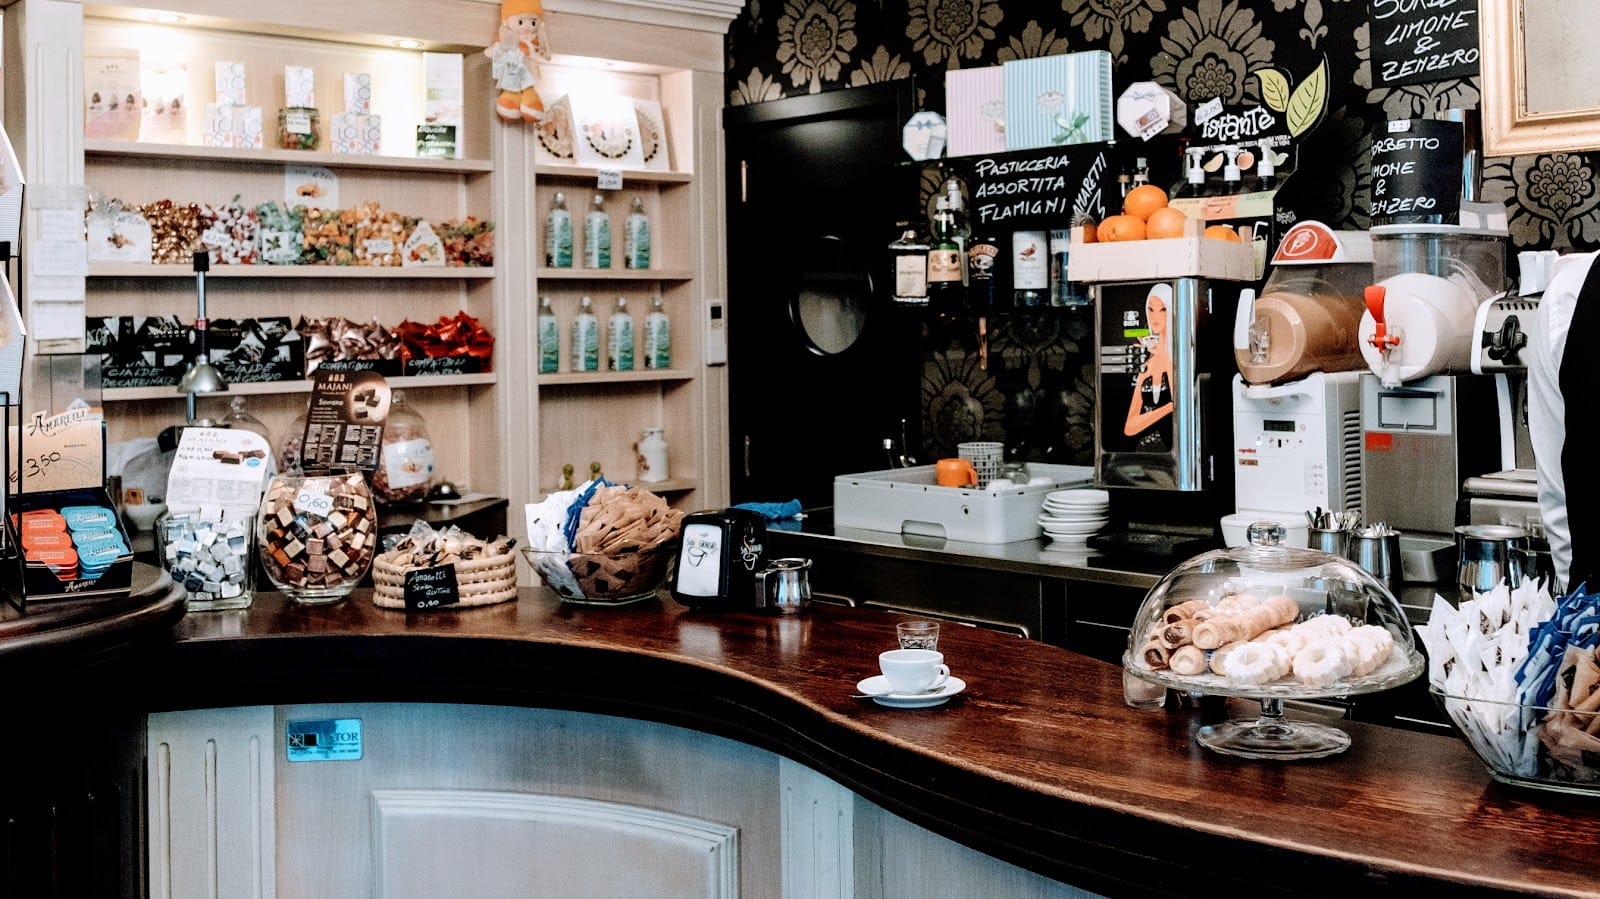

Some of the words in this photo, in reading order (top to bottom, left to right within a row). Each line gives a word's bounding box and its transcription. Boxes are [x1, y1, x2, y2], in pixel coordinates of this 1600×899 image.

[1385, 10, 1476, 46] LIMONE
[1413, 36, 1441, 55] &
[1382, 48, 1479, 81] ZENZERO
[1371, 137, 1440, 160] ORBETTO
[975, 154, 1070, 178] PASTICCERIA
[975, 175, 1066, 199] ASSORTITA
[1375, 178, 1387, 197] &
[977, 196, 1067, 224] FLAMIGNI
[1370, 196, 1436, 216] ENZERO
[317, 382, 353, 391] MAJANI
